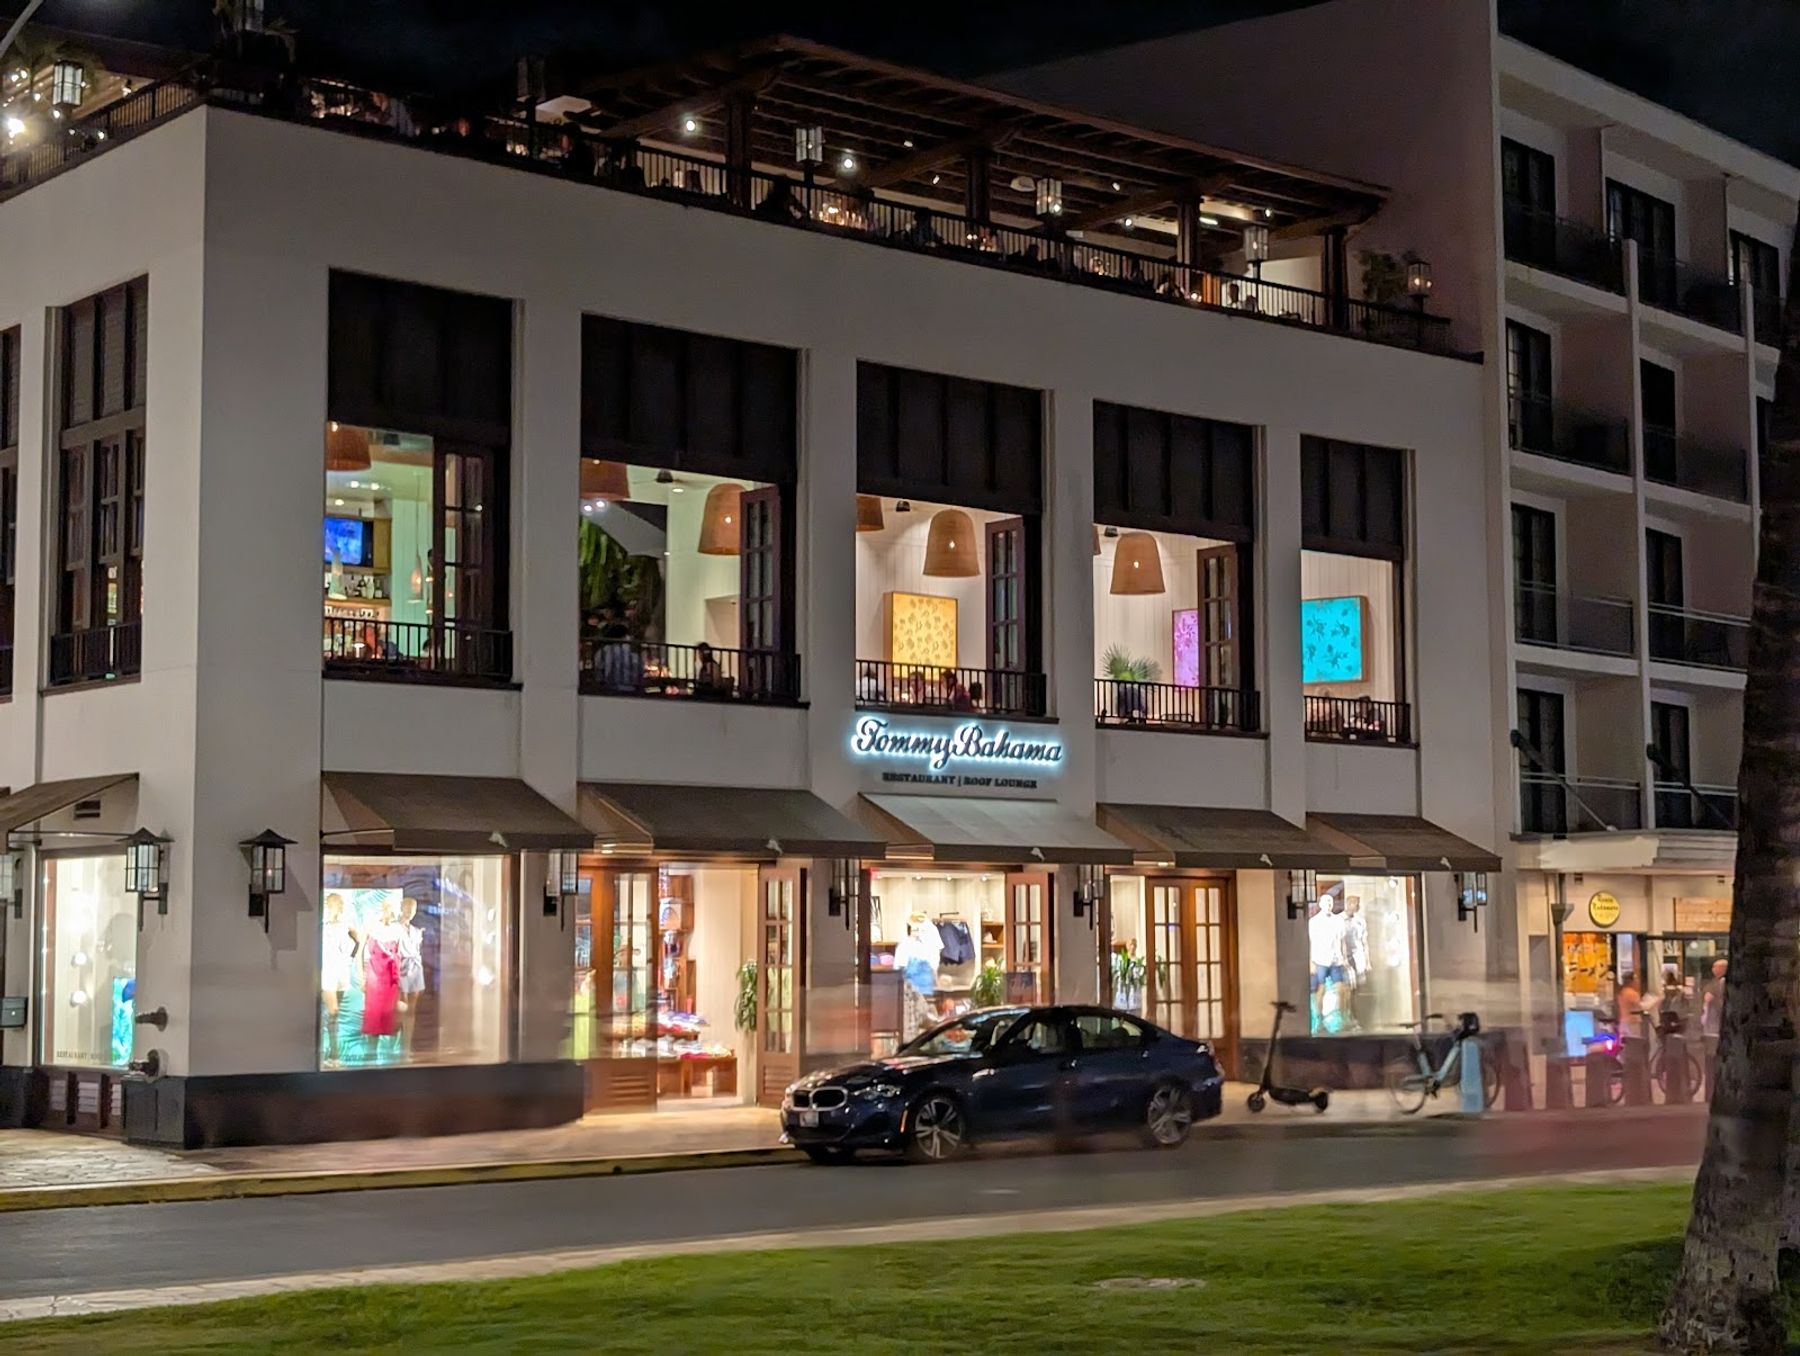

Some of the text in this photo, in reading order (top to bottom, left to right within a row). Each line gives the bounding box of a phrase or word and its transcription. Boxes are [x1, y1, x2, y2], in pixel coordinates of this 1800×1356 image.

[857, 718, 1063, 769] Tommy Bahama
[882, 772, 1038, 789] RESTAURANT ROOF LOUNGE
